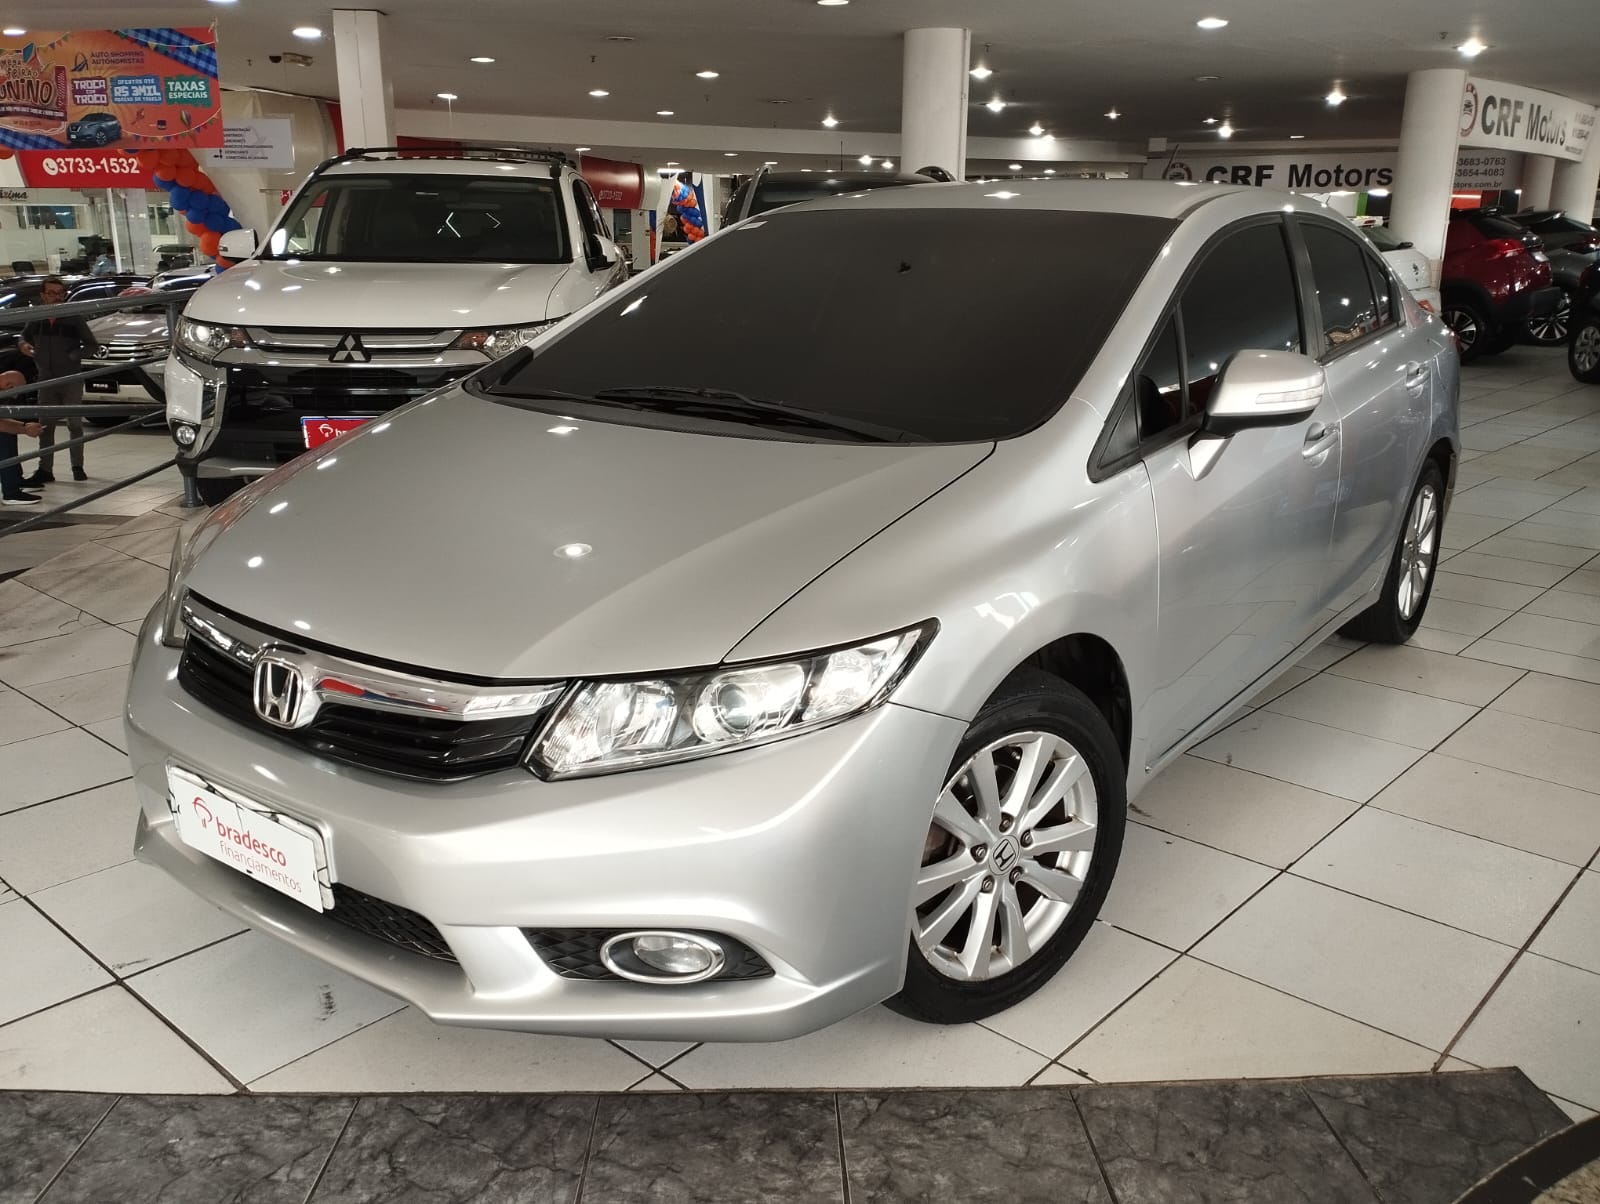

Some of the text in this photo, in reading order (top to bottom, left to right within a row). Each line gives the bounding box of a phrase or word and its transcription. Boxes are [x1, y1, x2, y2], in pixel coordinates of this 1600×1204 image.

[0, 79, 53, 103] UNINO
[74, 80, 106, 90] TROCA
[168, 81, 206, 91] TAXAS
[169, 91, 208, 99] ESPECIAIS
[75, 94, 107, 104] TROCO
[1481, 95, 1524, 138] CRF
[57, 157, 140, 174] 3733-1532
[1206, 165, 1275, 187] CRF
[1288, 163, 1394, 188] Motors
[215, 816, 287, 868] bradesco
[220, 840, 302, 894] financiamentos
